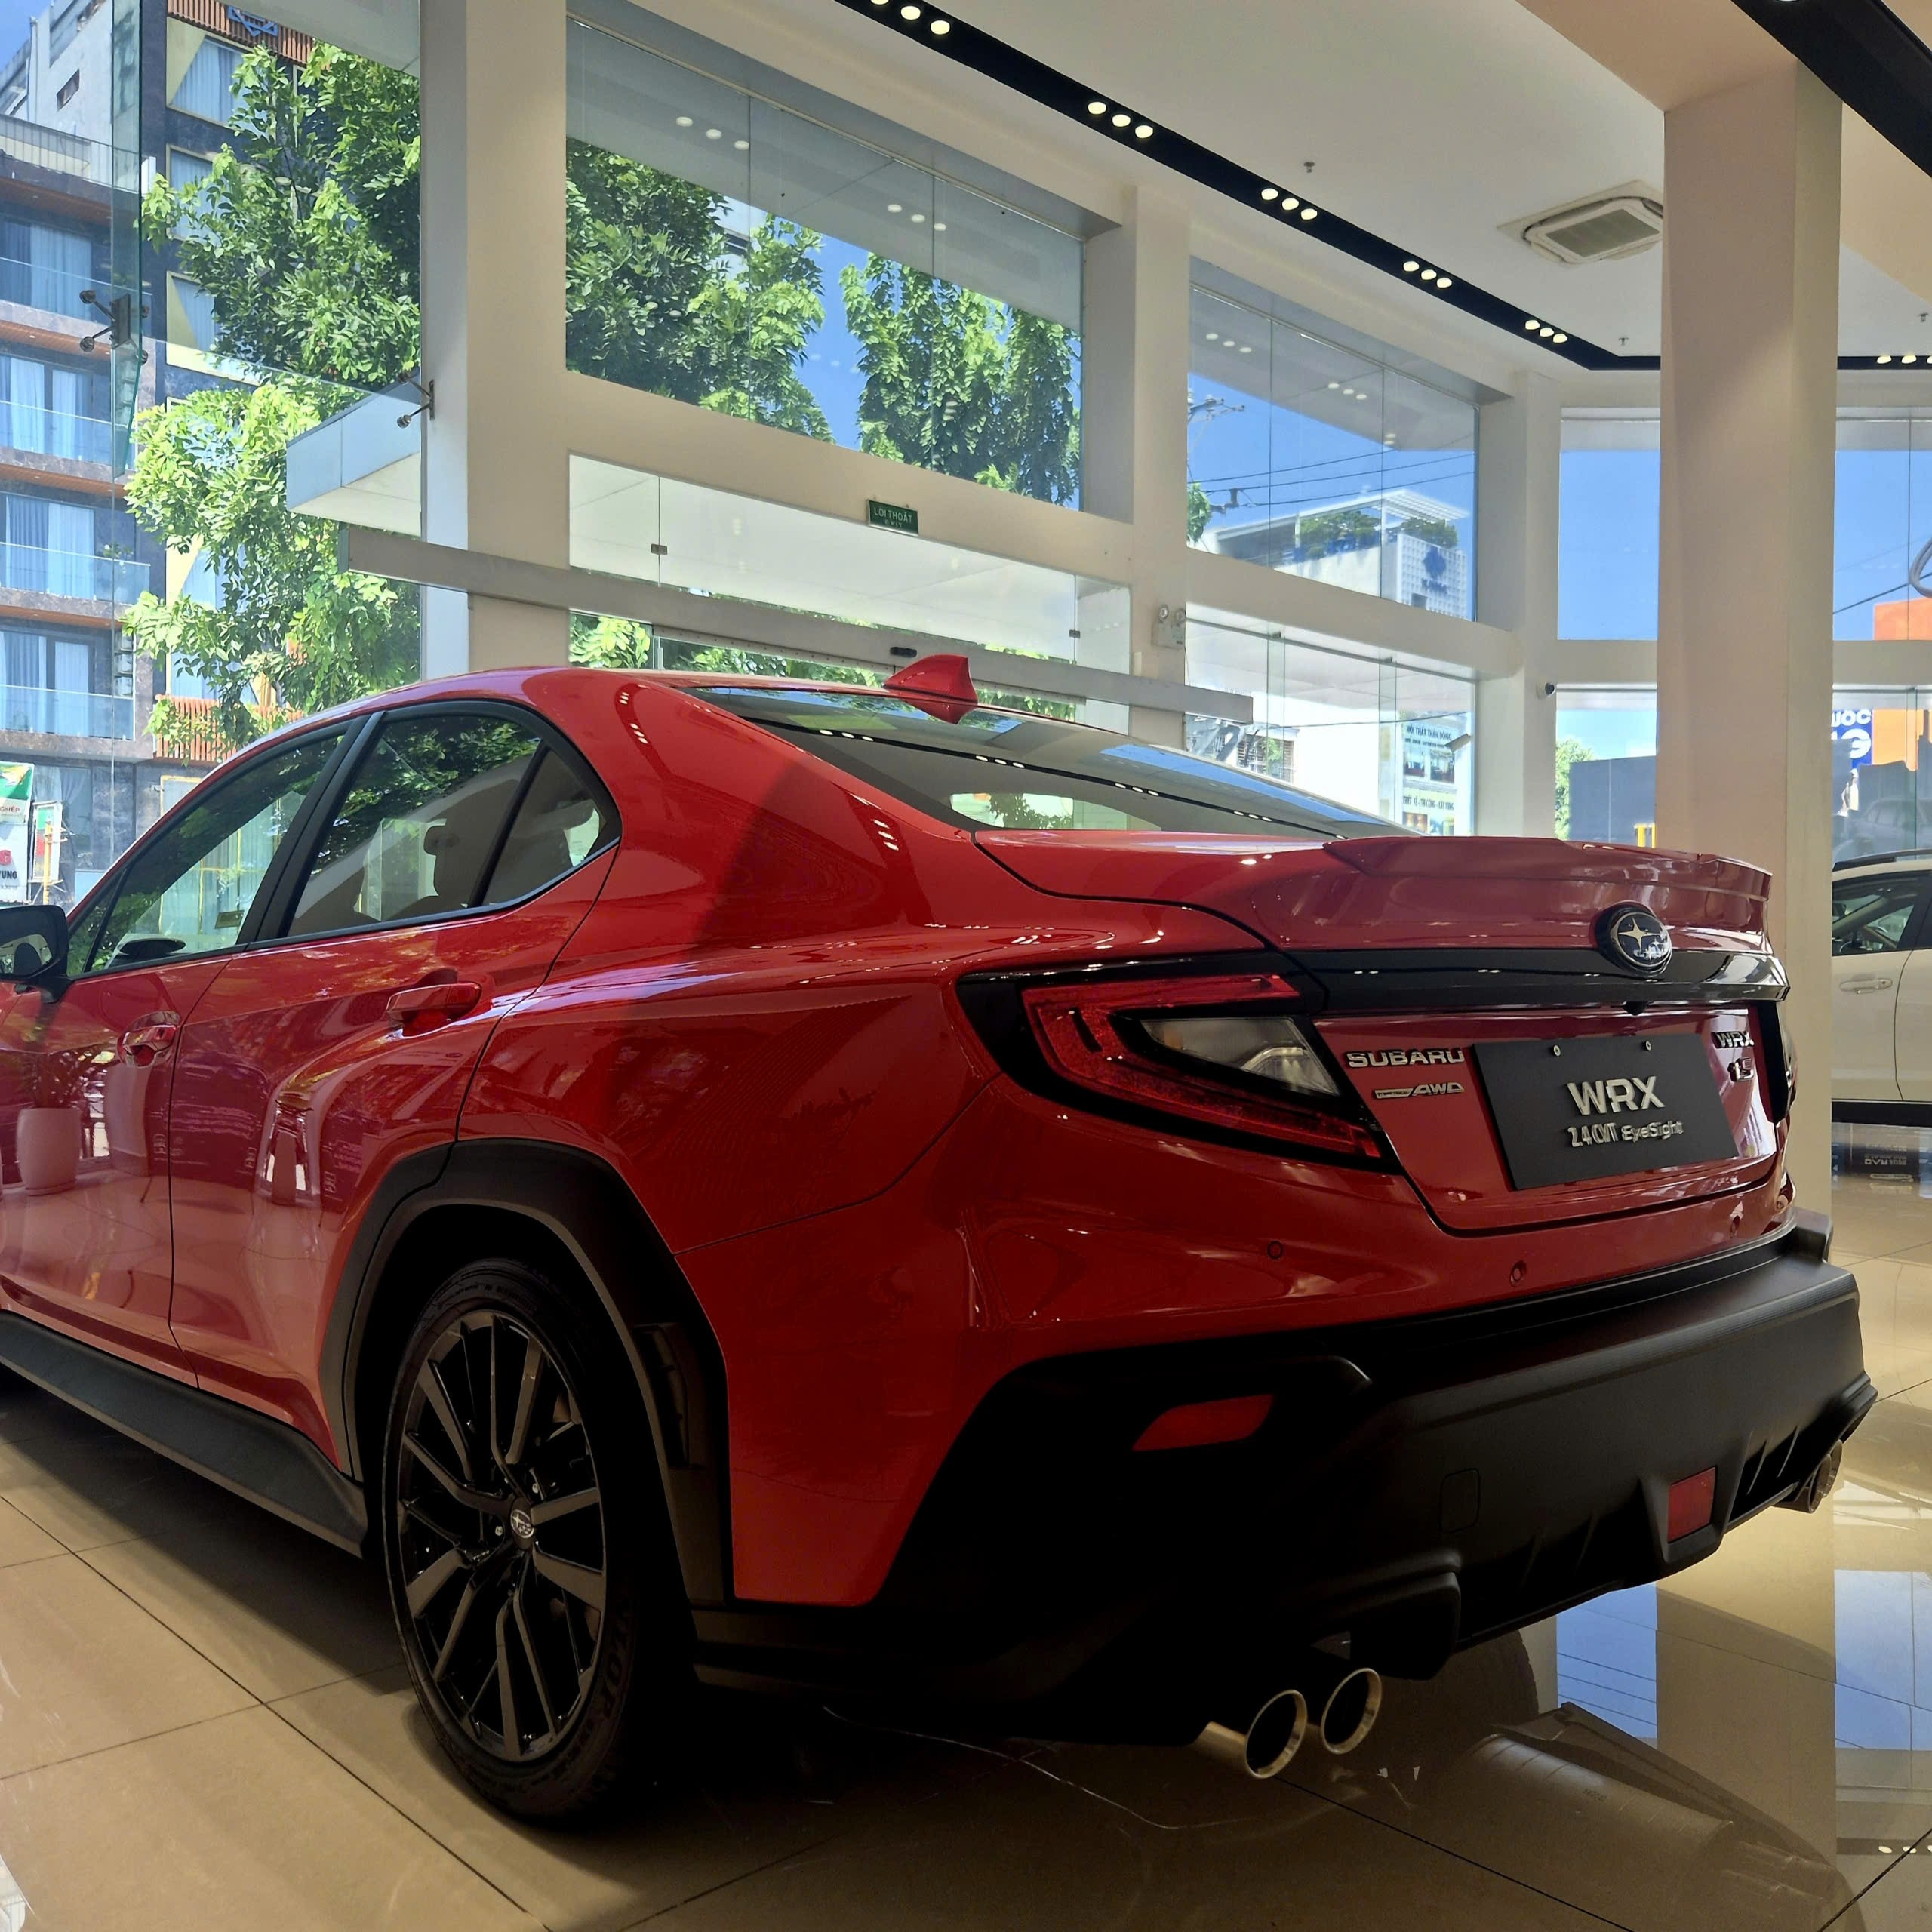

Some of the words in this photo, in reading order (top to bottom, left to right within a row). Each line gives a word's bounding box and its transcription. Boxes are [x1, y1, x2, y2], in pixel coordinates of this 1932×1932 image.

[0, 870, 17, 880] UNG
[1715, 1032, 1755, 1048] WRX
[1346, 1049, 1466, 1068] SUBARU
[1411, 1081, 1465, 1097] AWD
[1567, 1075, 1666, 1115] WRX
[1621, 1120, 1684, 1143] EyeSight
